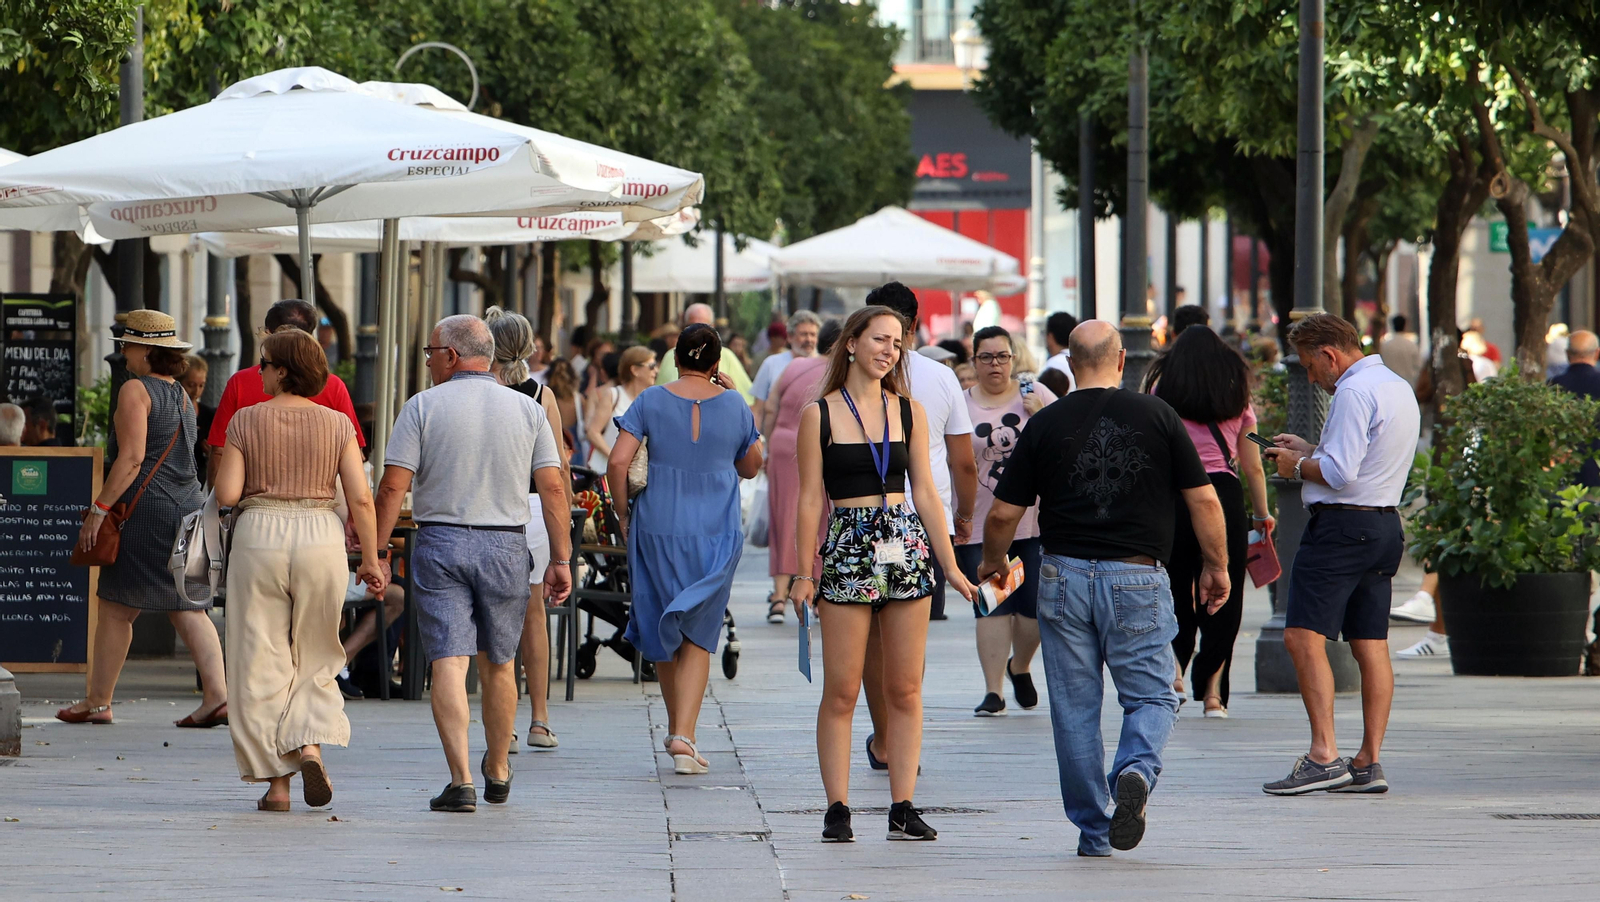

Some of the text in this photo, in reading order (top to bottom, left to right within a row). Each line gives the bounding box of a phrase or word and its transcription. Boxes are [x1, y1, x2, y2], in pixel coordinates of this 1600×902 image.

[388, 147, 499, 164] Cruzcampo
[915, 152, 968, 178] AES
[5, 347, 71, 360] MENU DEL DIA
[43, 518, 53, 526] DE
[56, 518, 72, 526] SAN
[20, 533, 32, 541] EN
[39, 533, 68, 541] ADOBO
[30, 565, 56, 574] FRITO
[25, 580, 34, 588] DE
[40, 580, 72, 589] HUELVA
[39, 612, 71, 622] VAPOR
